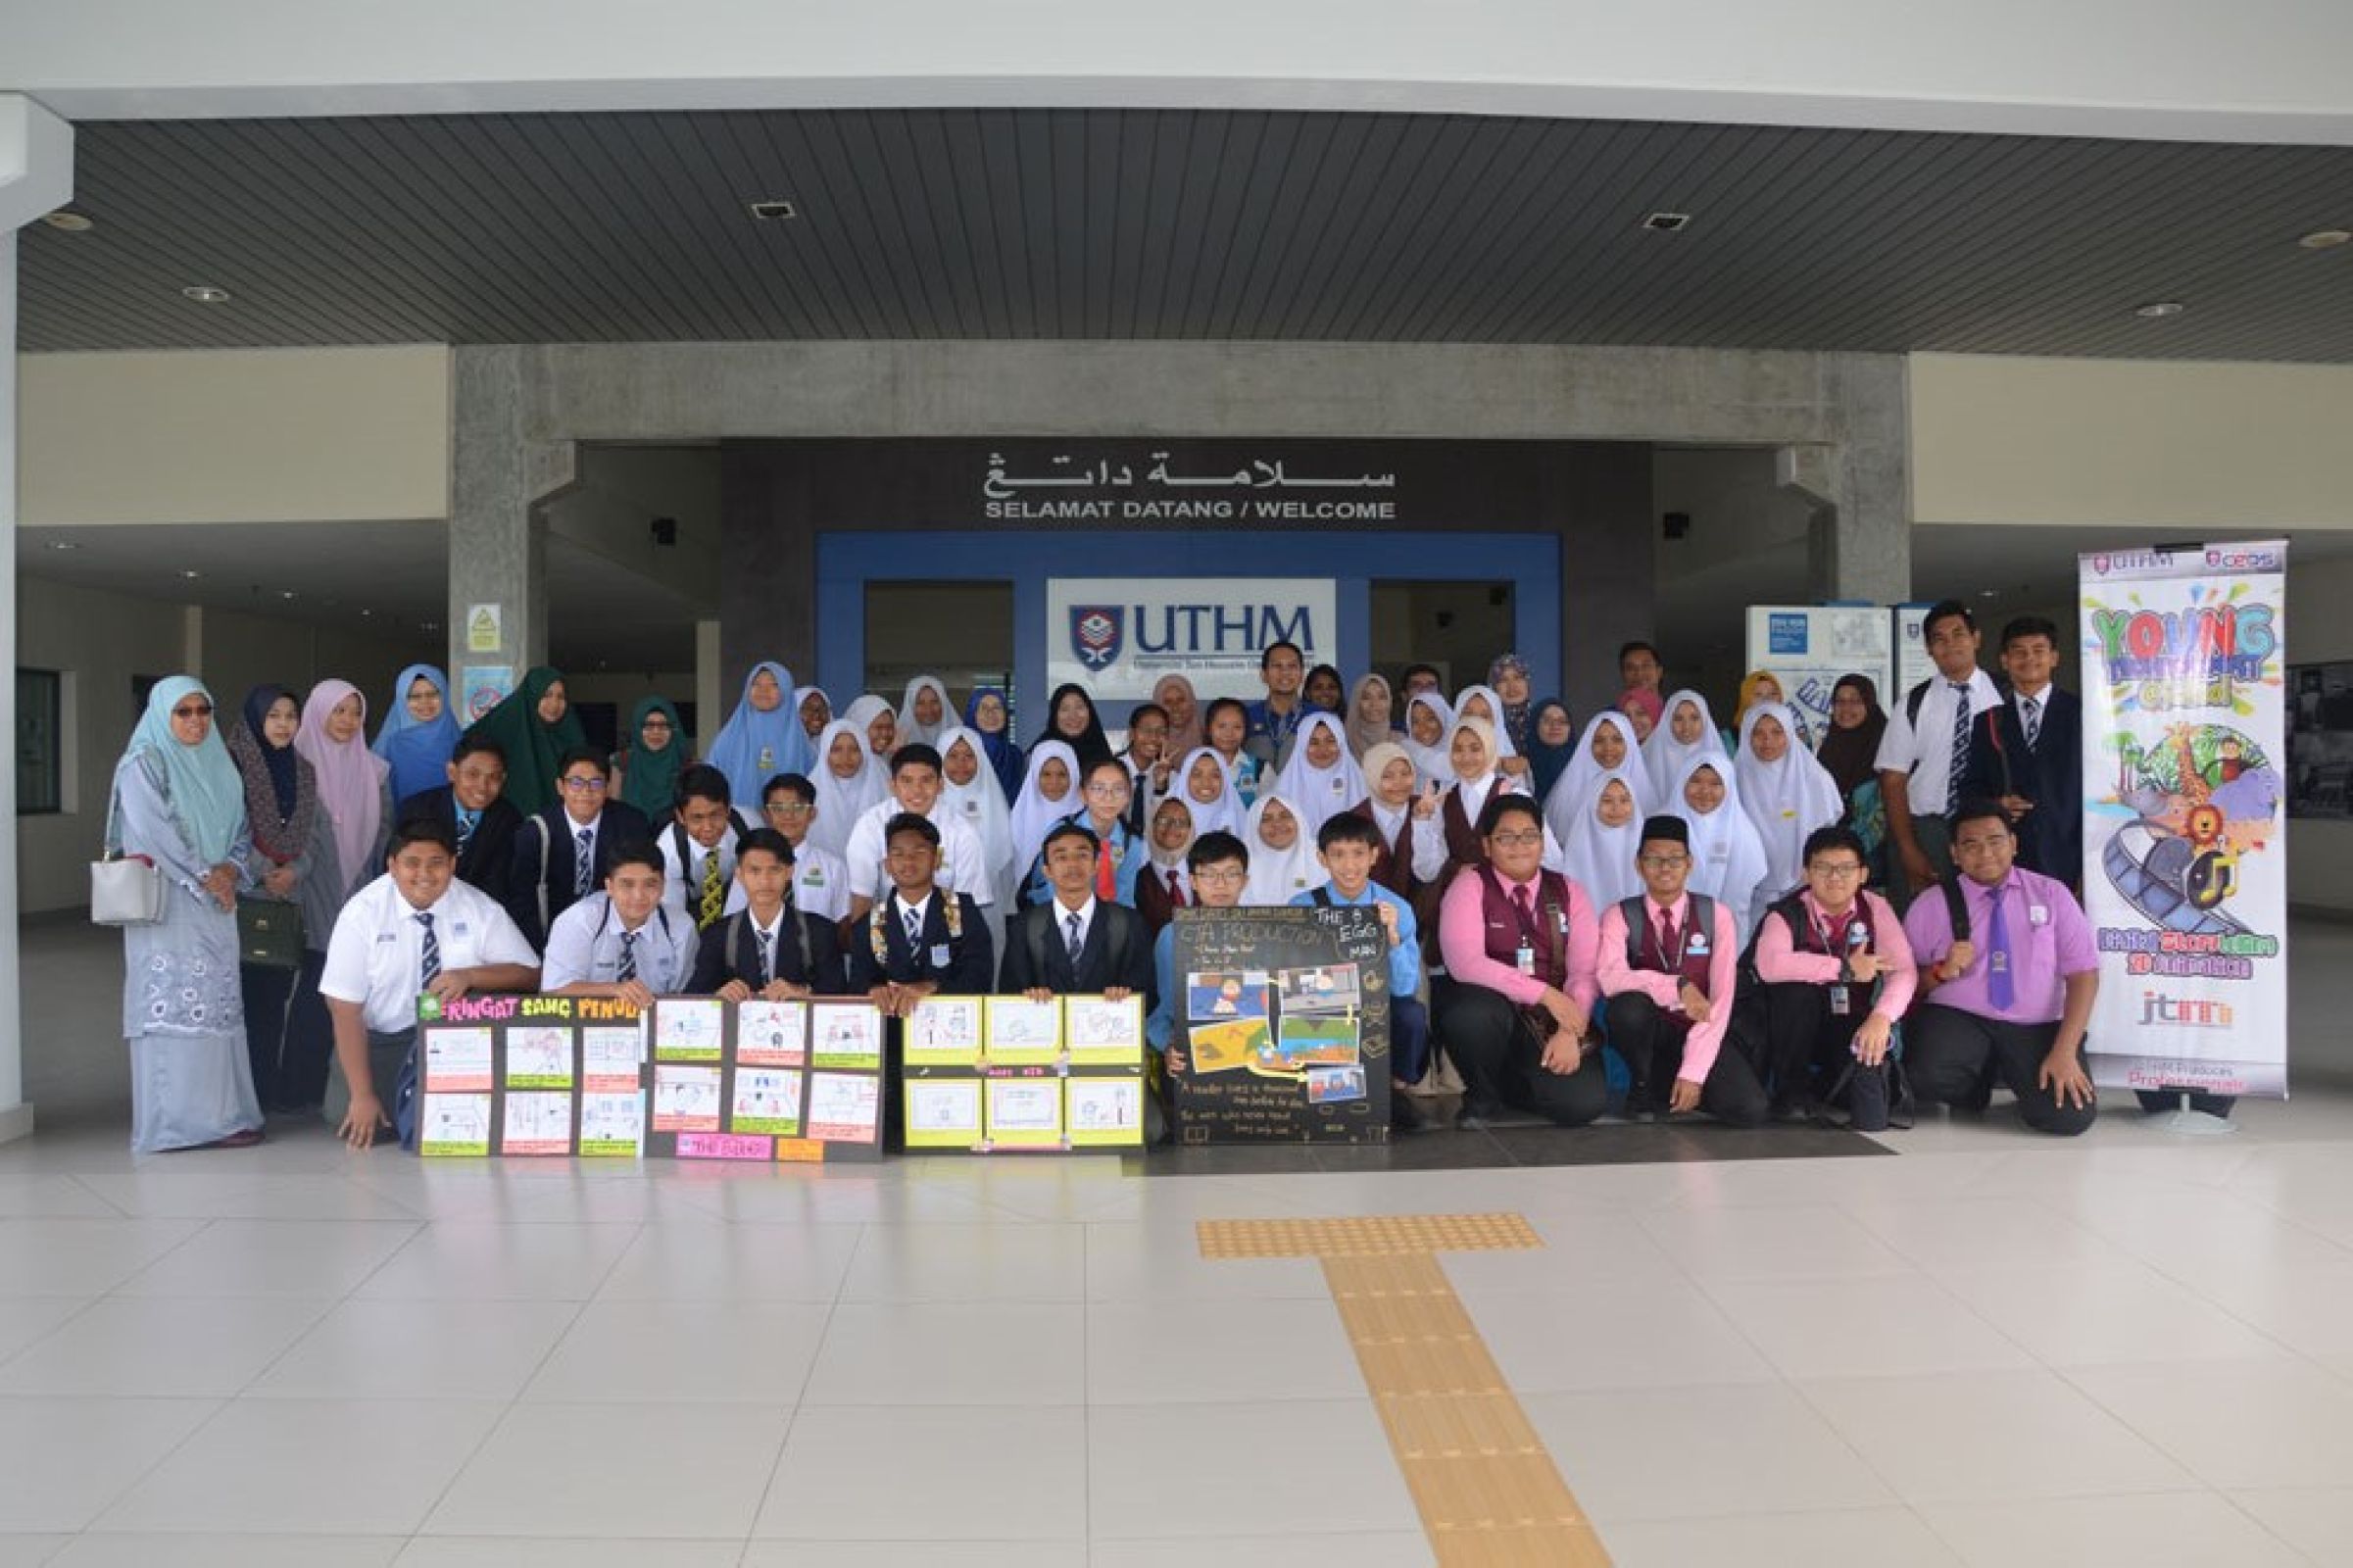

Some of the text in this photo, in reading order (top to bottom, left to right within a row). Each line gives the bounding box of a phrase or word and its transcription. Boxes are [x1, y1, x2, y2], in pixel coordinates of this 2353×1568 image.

[985, 501, 1114, 519] SELAMAT
[1123, 501, 1233, 519] DATANG
[1255, 501, 1397, 519] WELCOME
[1133, 604, 1314, 654] UTHM
[2092, 603, 2276, 661] YOUNG
[1313, 908, 1344, 923] THE
[1340, 923, 1378, 943] EGG
